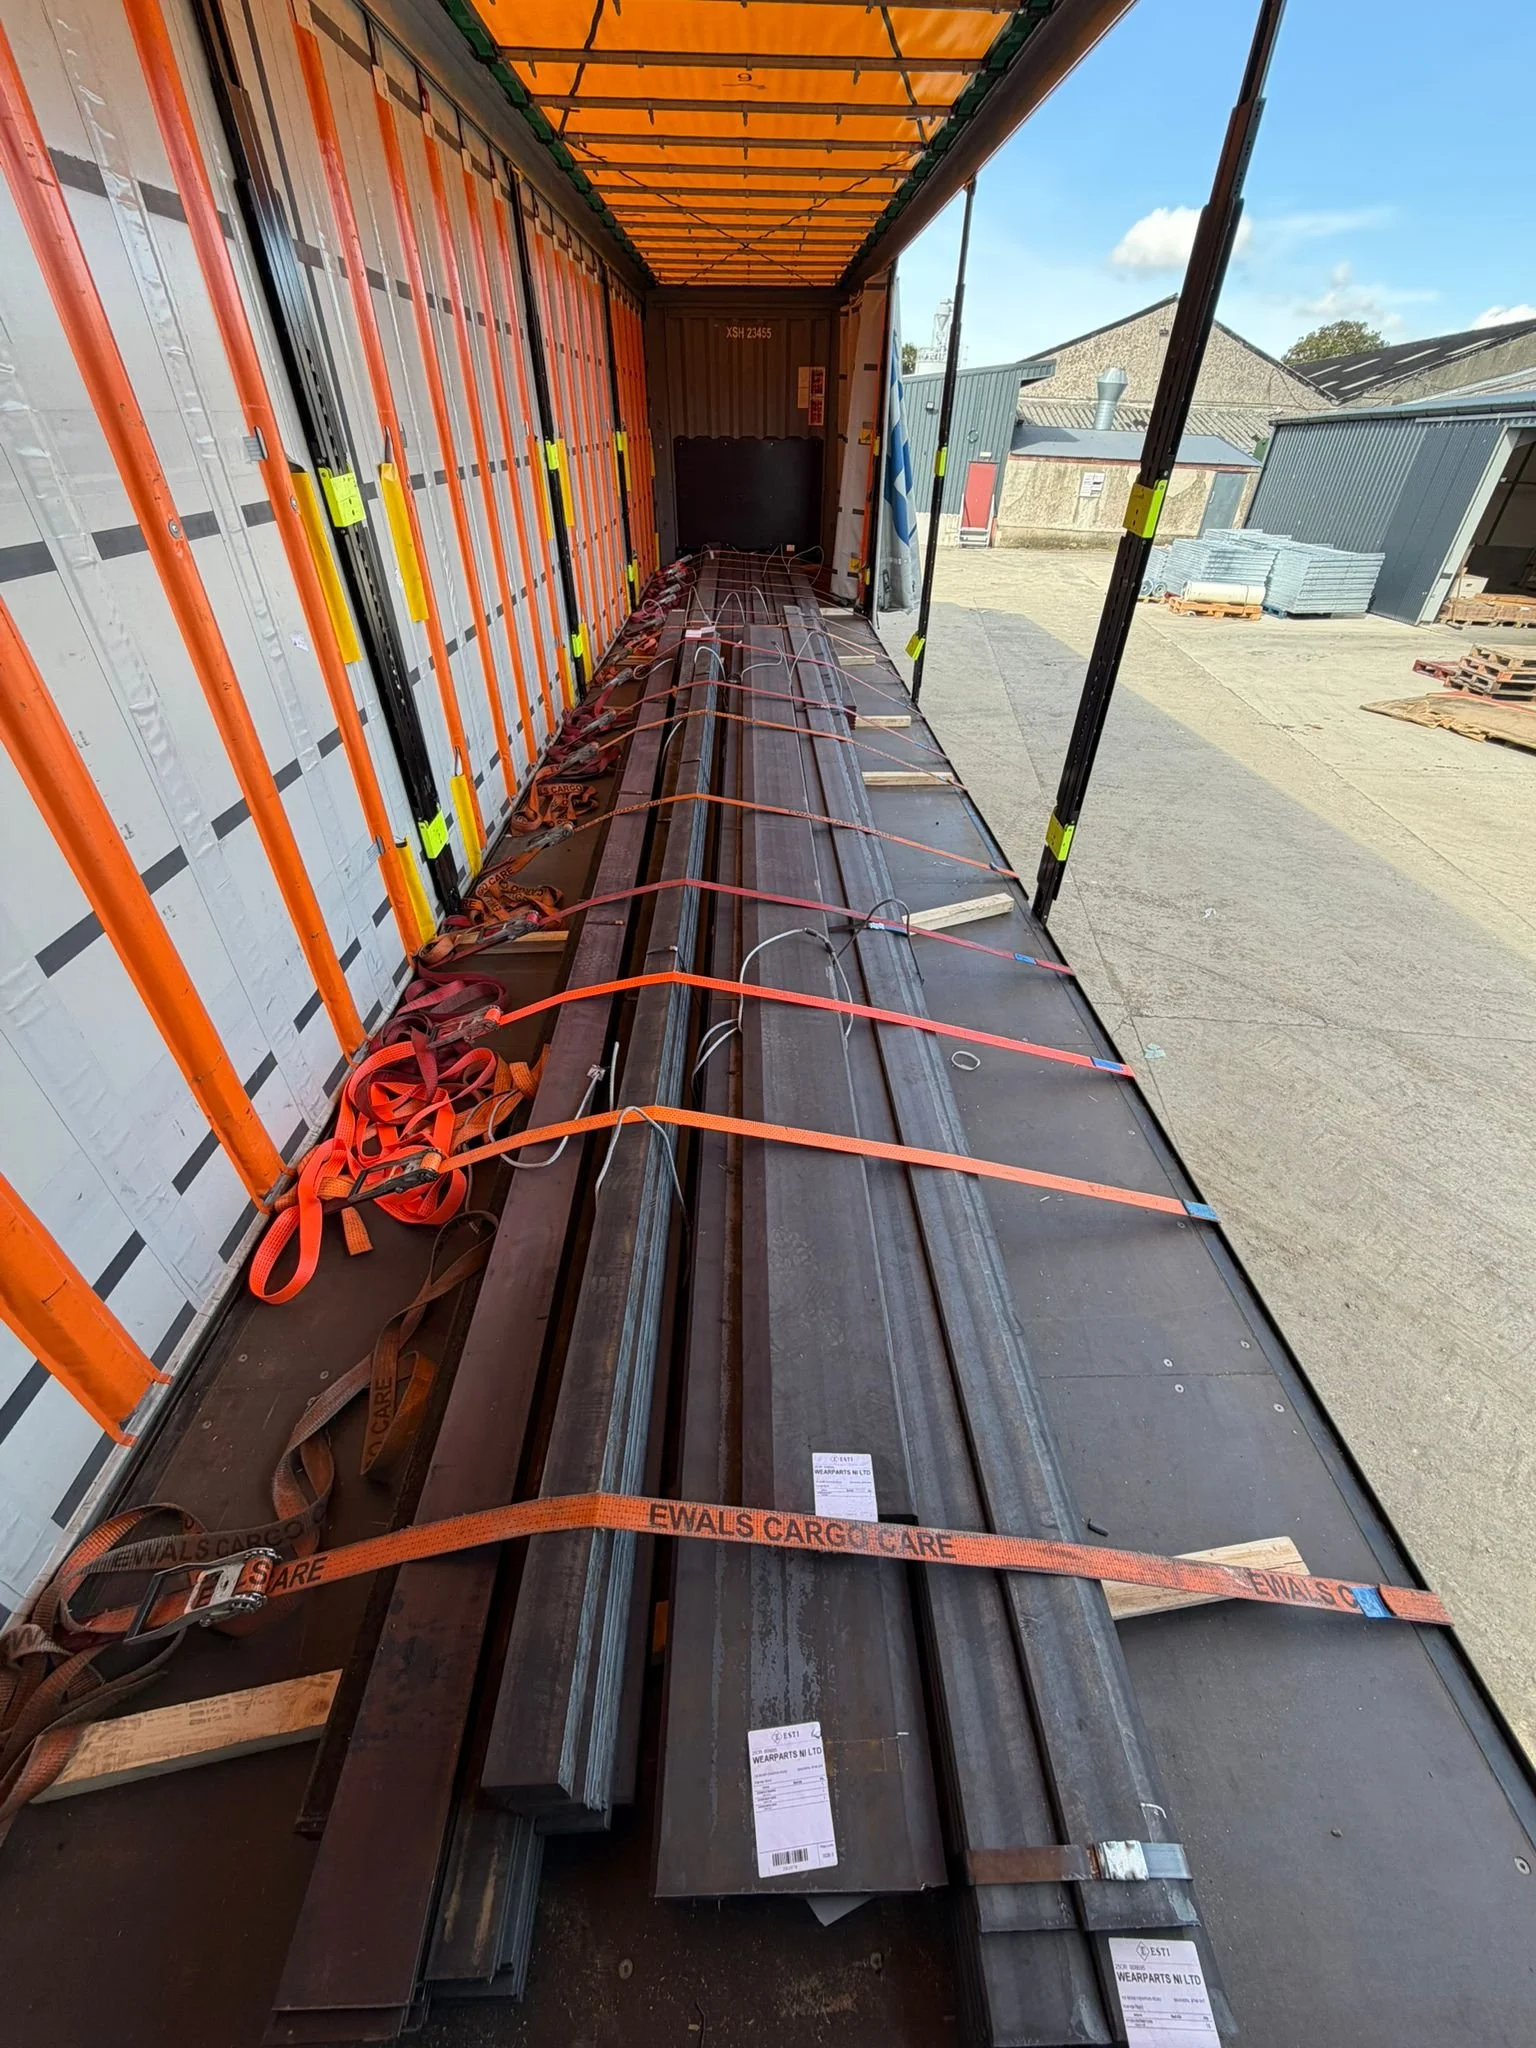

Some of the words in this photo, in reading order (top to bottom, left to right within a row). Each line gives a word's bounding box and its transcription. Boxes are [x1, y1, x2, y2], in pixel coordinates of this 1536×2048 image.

[726, 326, 745, 339] XSH
[747, 327, 772, 339] 23455
[551, 784, 582, 794] CARGO
[370, 1376, 392, 1435] CARE
[650, 1503, 753, 1538] EWALS
[763, 1516, 868, 1550] CARGO
[878, 1529, 957, 1559] CARE
[114, 1537, 208, 1568] EWALS
[215, 1521, 304, 1553] CARGO
[1250, 1572, 1334, 1605] EWALS
[783, 1731, 800, 1740] ESTI
[752, 1750, 798, 1764] WEARPARTS
[799, 1748, 807, 1758] NI
[808, 1746, 823, 1757] LTD
[1150, 1946, 1170, 1957] ESTI
[1117, 1972, 1171, 1984] WEARPARTS
[1173, 1974, 1183, 1984] NI
[1185, 1975, 1201, 1986] LTD
